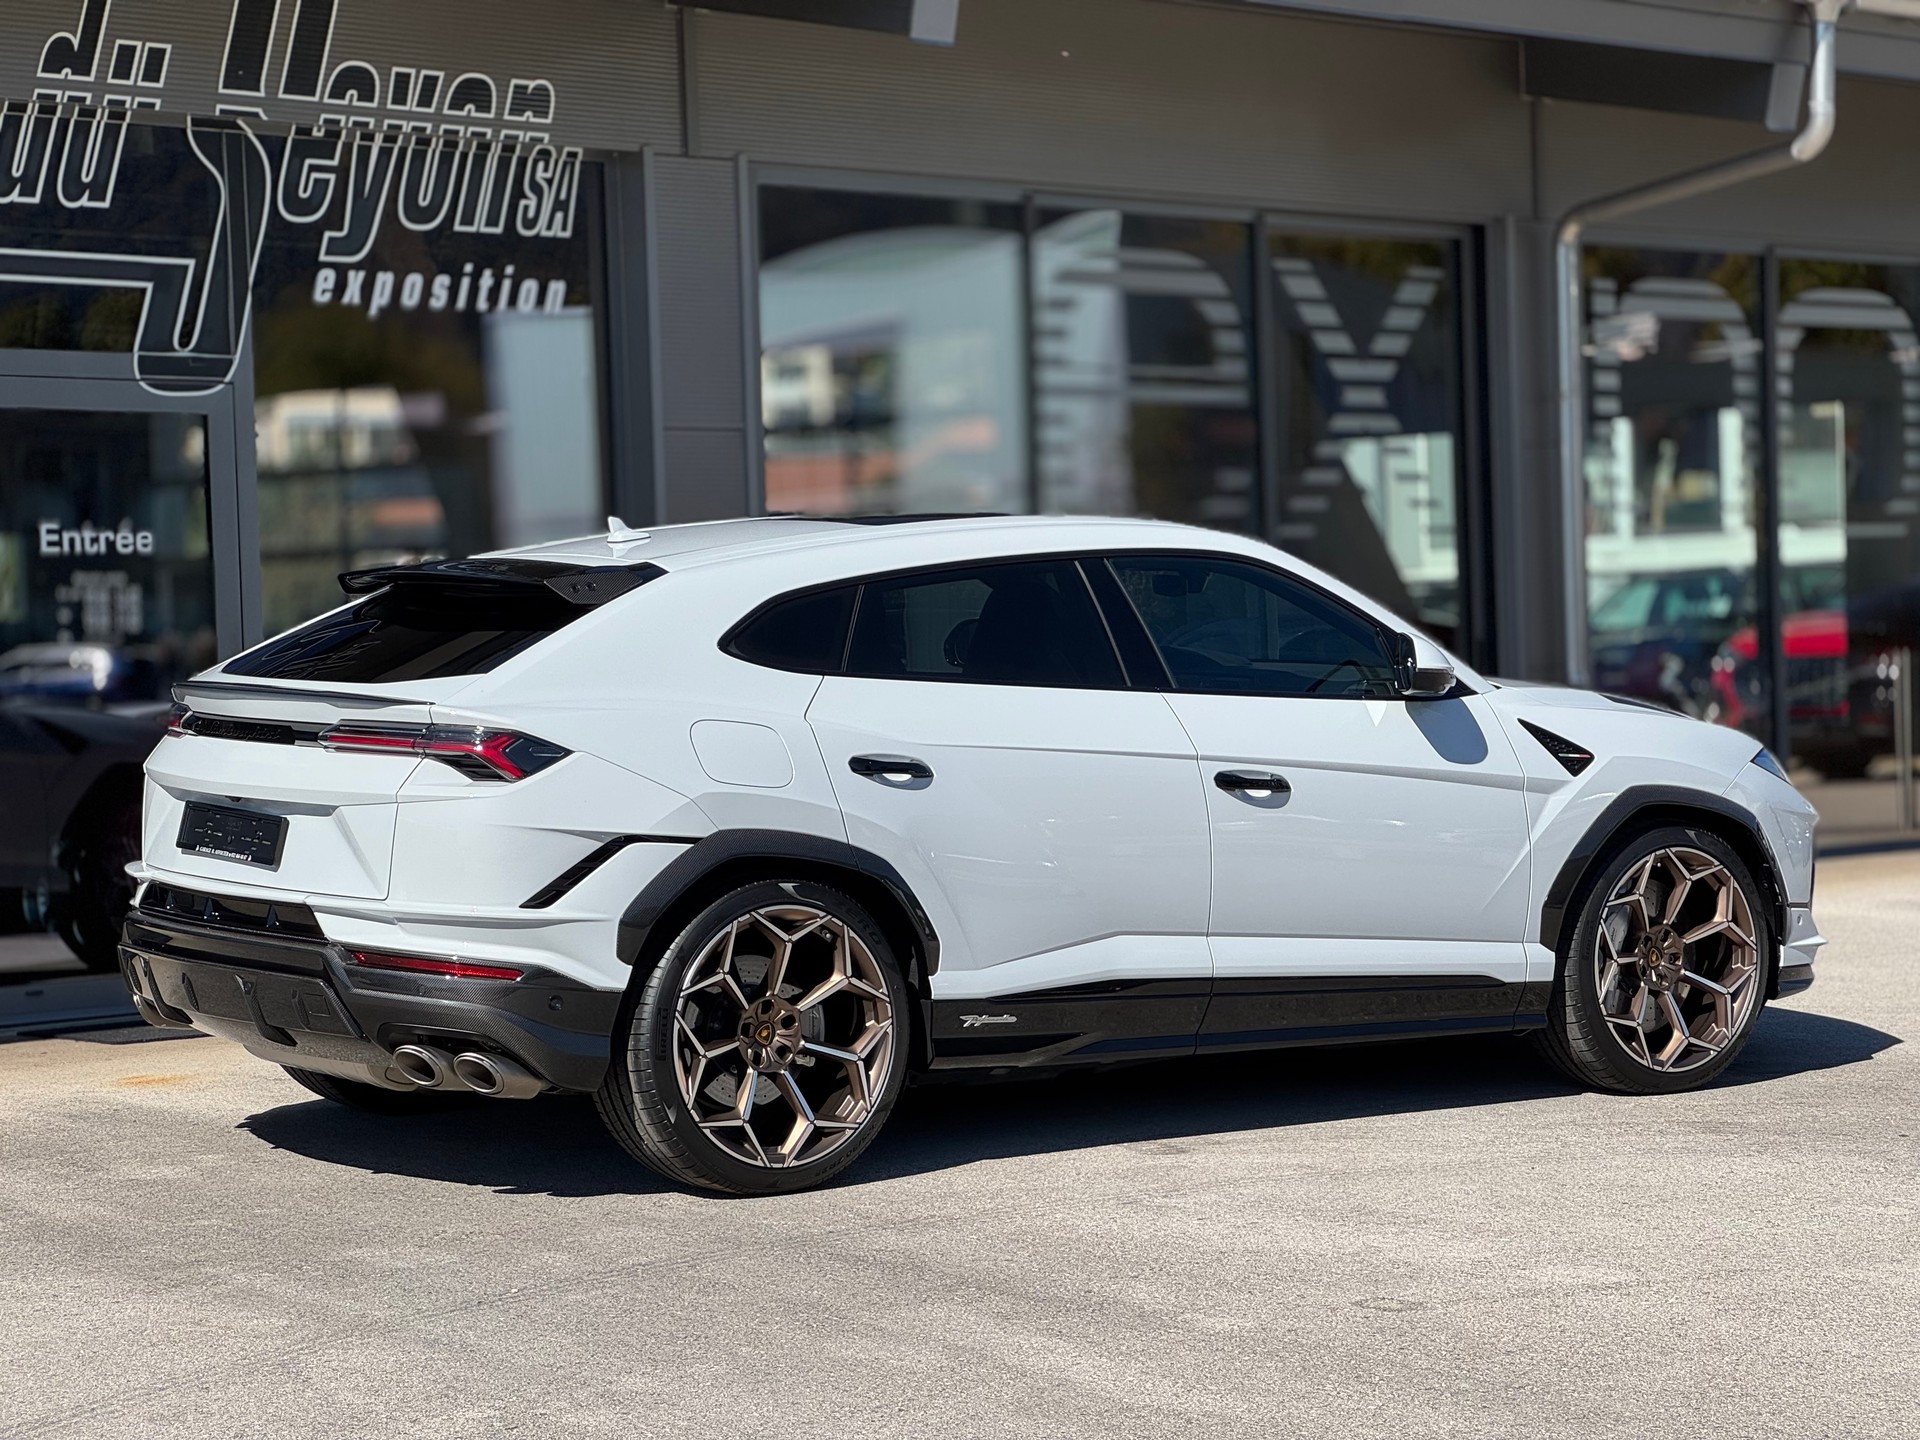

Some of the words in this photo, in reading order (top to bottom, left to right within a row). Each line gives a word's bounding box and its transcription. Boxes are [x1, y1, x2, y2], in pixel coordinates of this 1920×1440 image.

[516, 145, 583, 239] SA
[312, 262, 568, 319] exposition
[38, 519, 154, 556] Entrée
